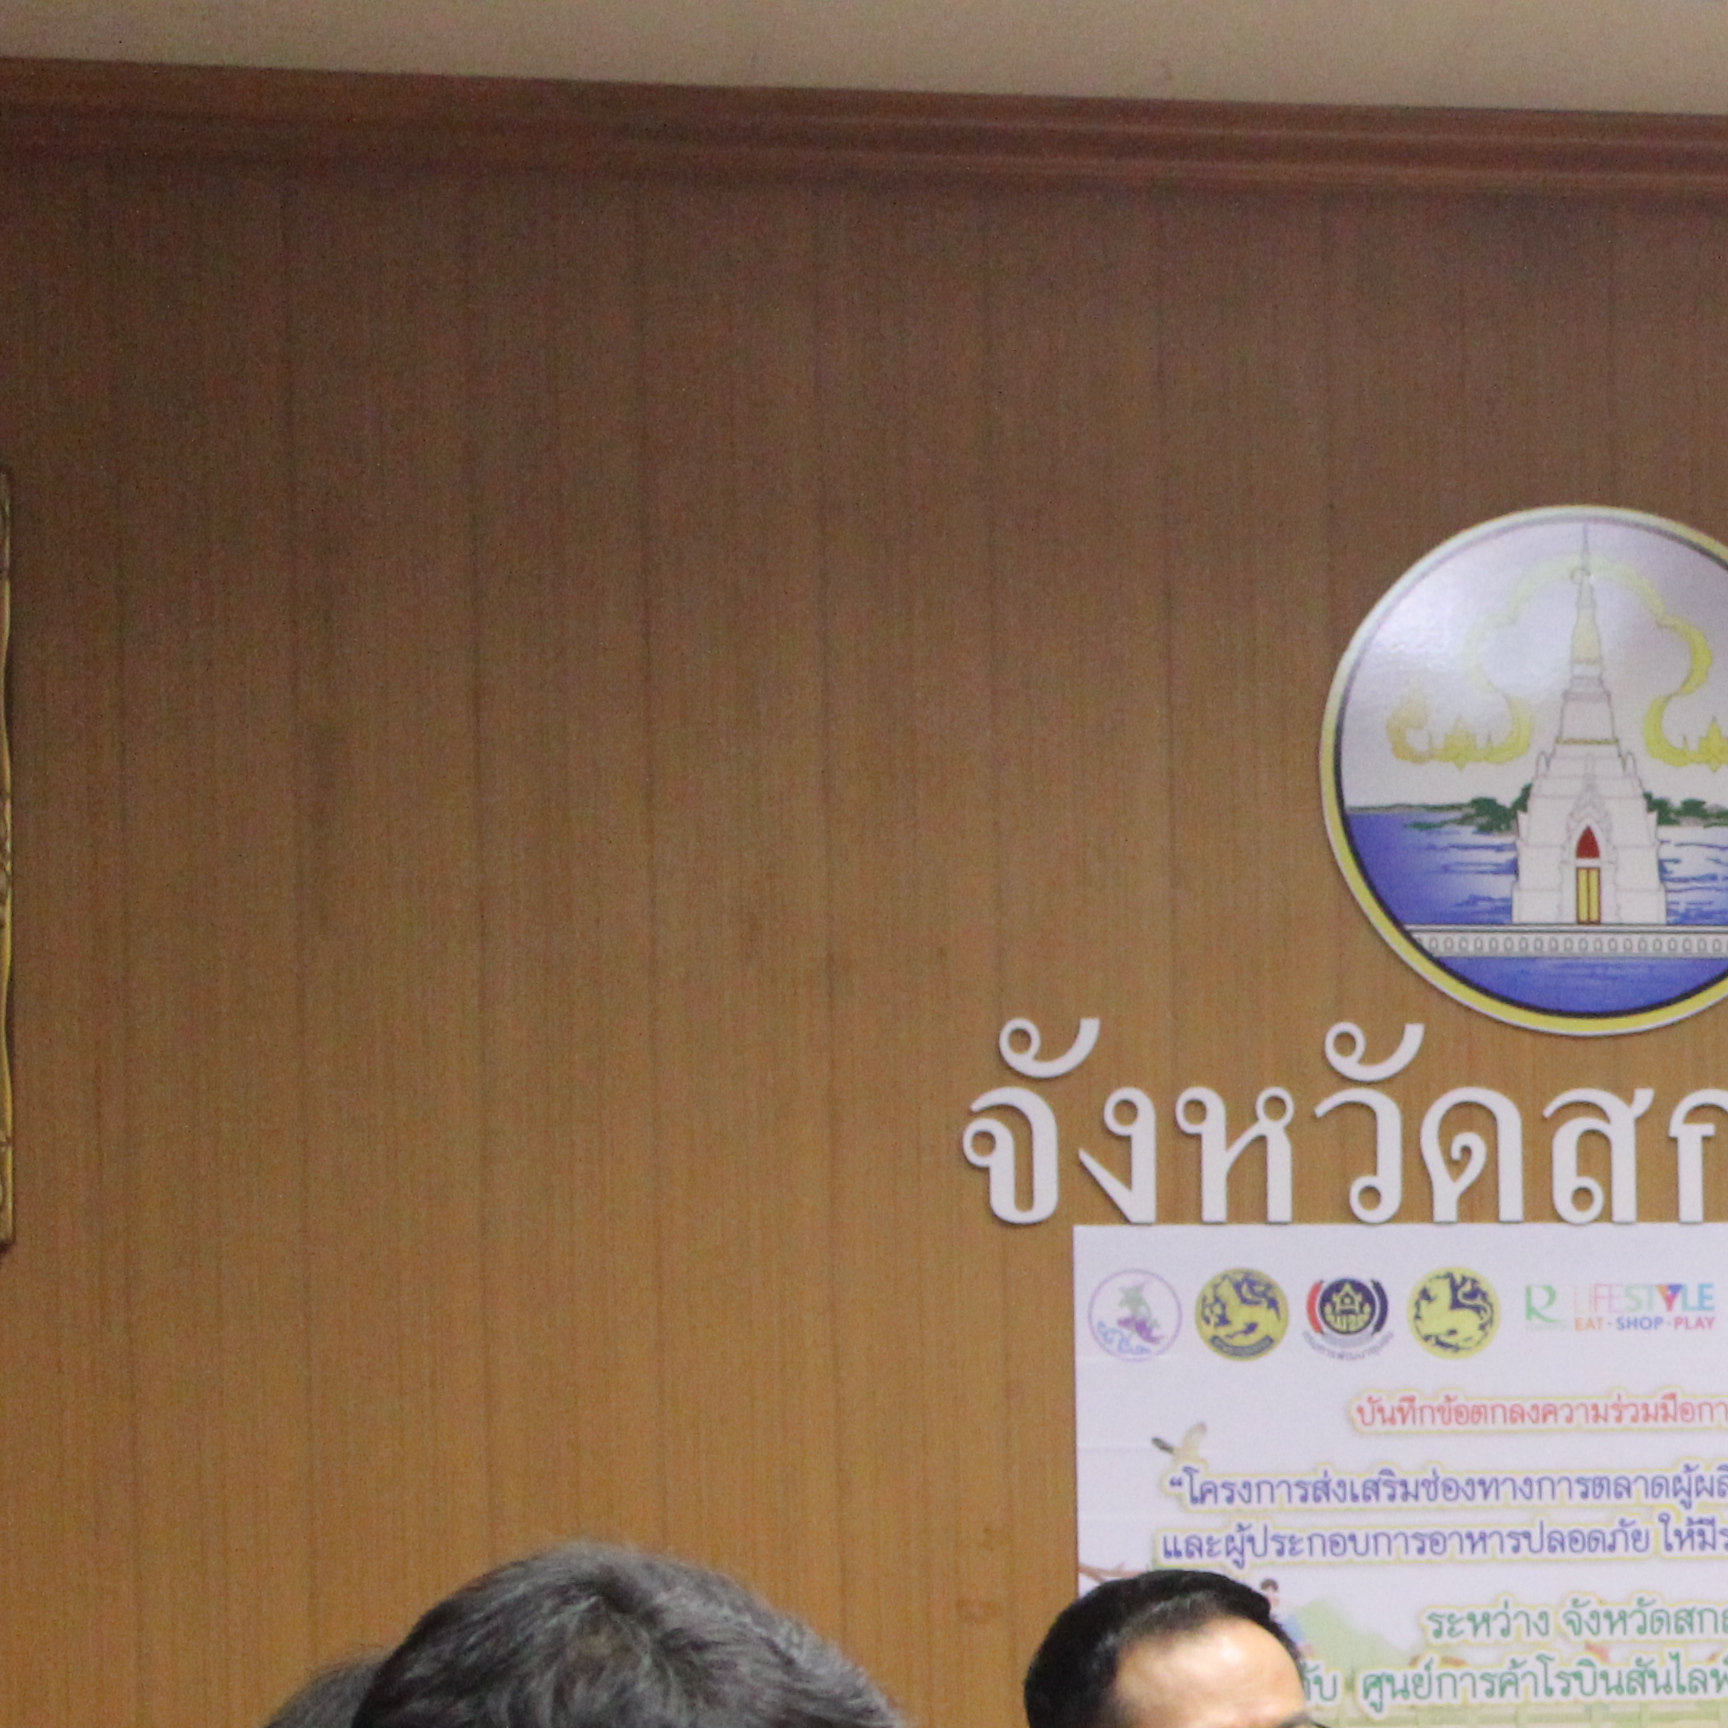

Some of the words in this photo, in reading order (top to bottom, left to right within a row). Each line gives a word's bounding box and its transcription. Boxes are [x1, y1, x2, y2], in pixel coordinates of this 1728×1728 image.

[1572, 1281, 1716, 1314] LIFESTYLE
[1574, 1317, 1604, 1332] EAT
[1616, 1316, 1664, 1331] SHOP
[1673, 1315, 1716, 1331] PLAY
[1161, 1517, 1651, 1569] และผู้ประกอบการอาหารปลอดภัย
[1426, 1599, 1550, 1639] ระหว่าง
